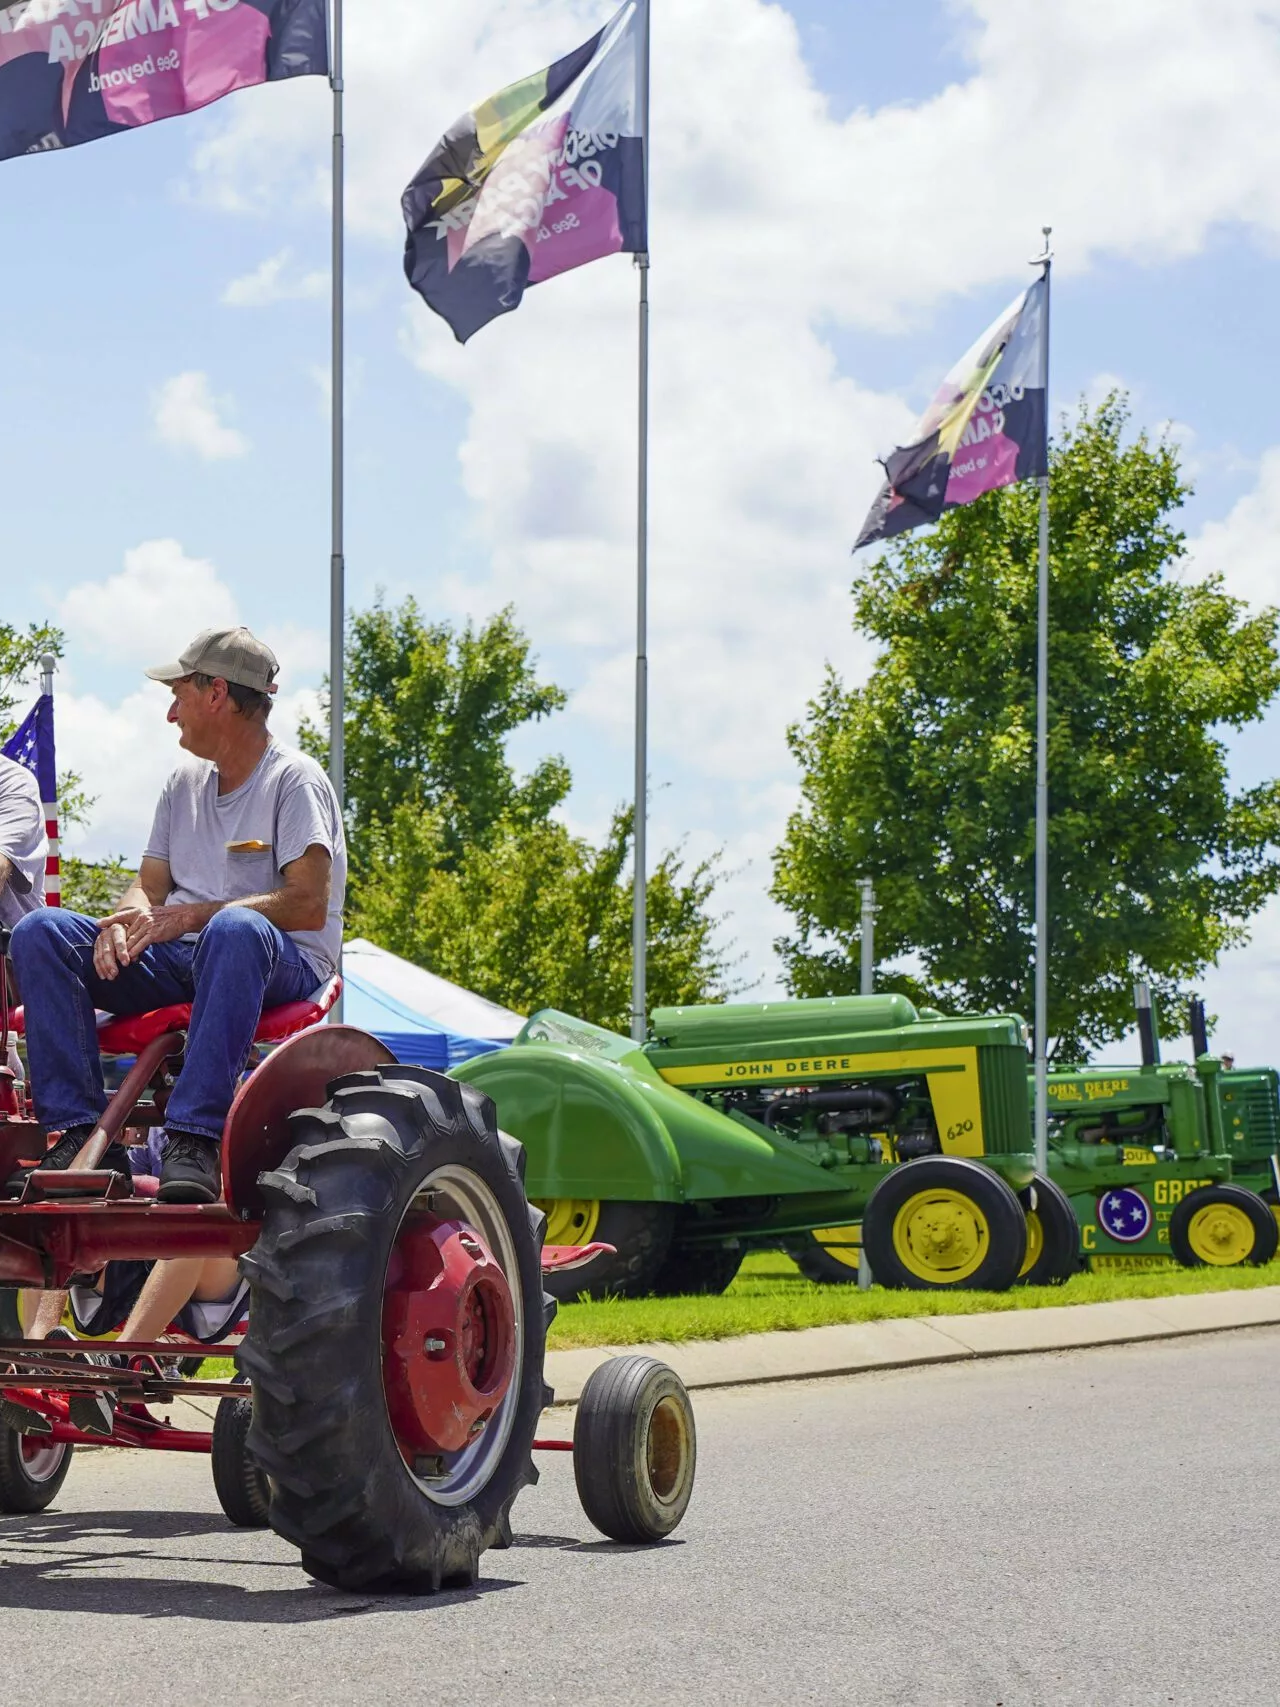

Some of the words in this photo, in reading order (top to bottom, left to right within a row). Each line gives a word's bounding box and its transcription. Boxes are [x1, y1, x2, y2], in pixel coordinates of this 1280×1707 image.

[724, 1063, 774, 1077] JOHN
[786, 1058, 851, 1073] DEERE
[1047, 1083, 1078, 1097] OHN
[1084, 1080, 1129, 1094] DEERE
[946, 1119, 974, 1141] 620
